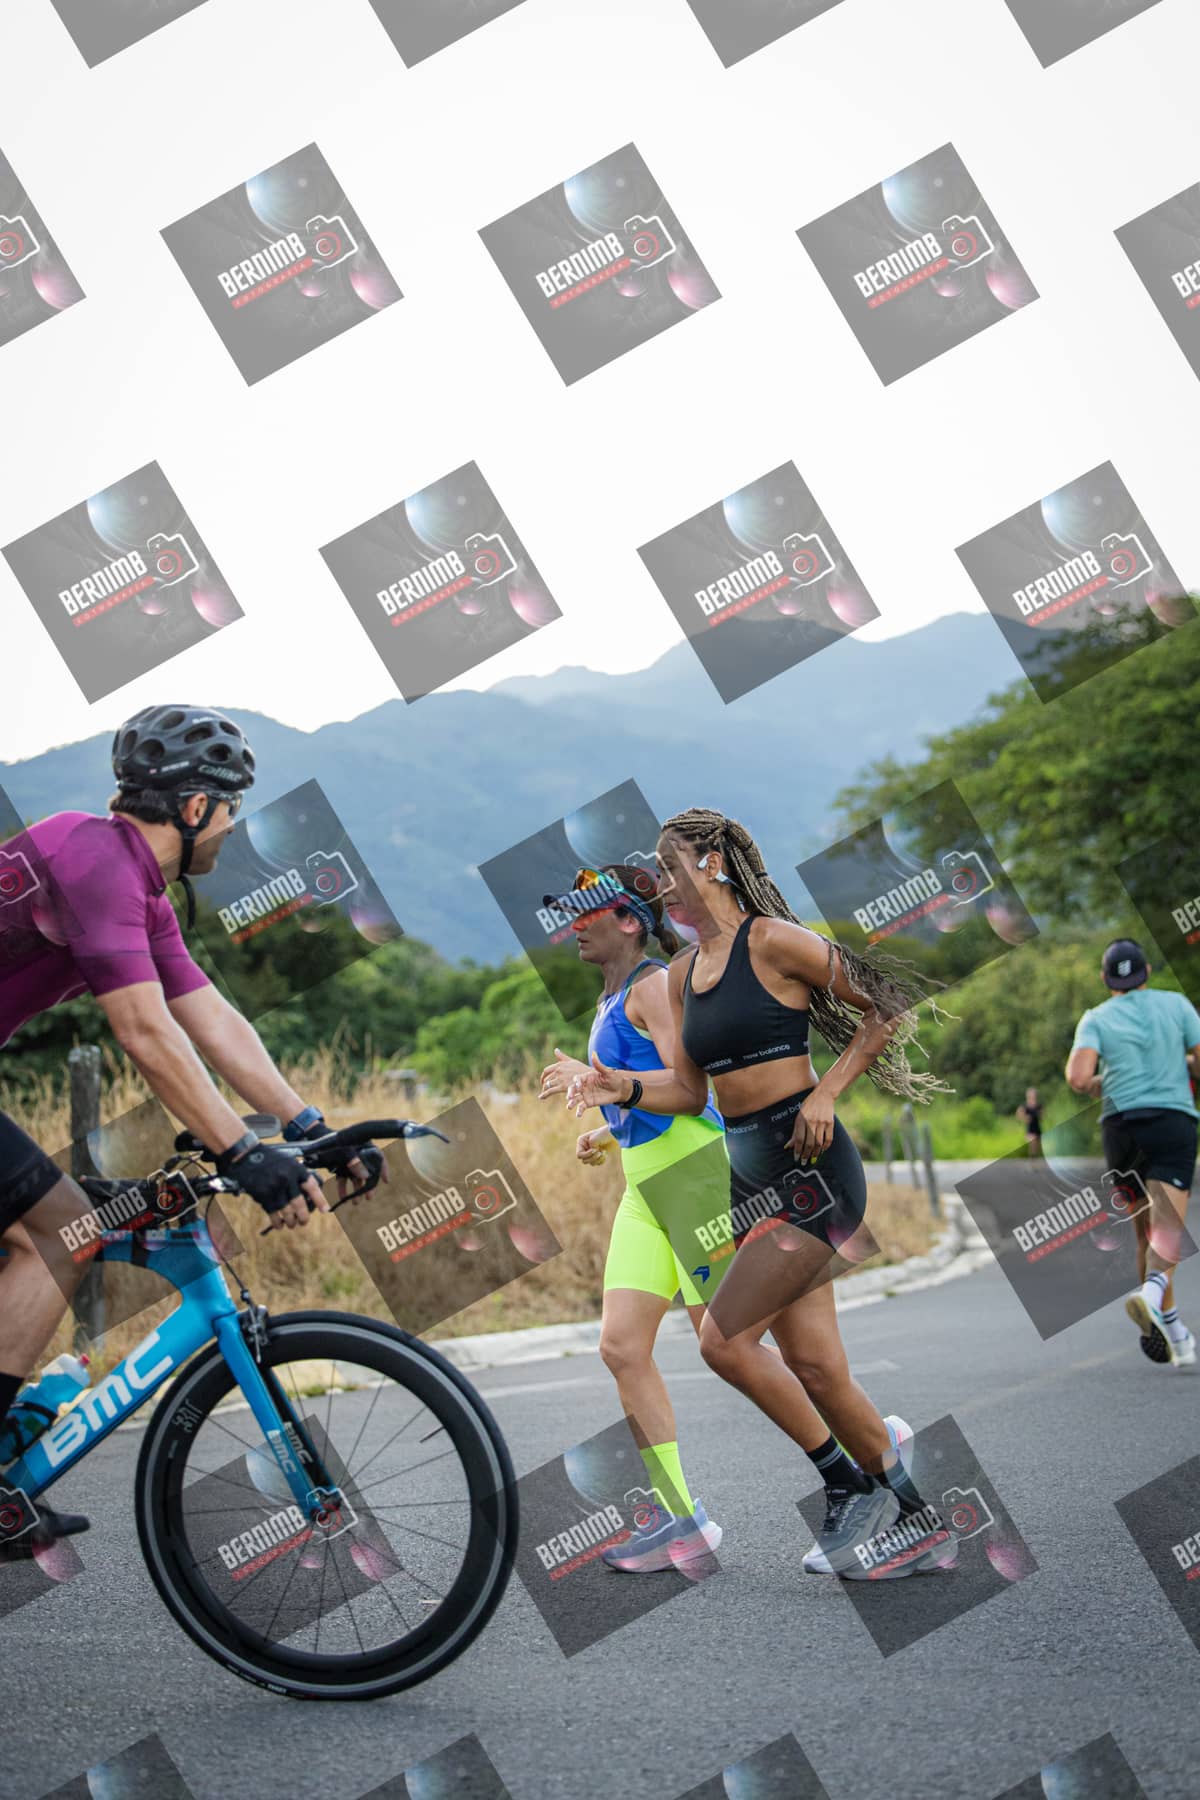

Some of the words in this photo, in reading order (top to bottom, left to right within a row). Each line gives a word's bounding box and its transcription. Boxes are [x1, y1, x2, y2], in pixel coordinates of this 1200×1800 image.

[758, 1043, 791, 1057] balance
[771, 1110, 789, 1122] new
[40, 1330, 174, 1468] BMC
